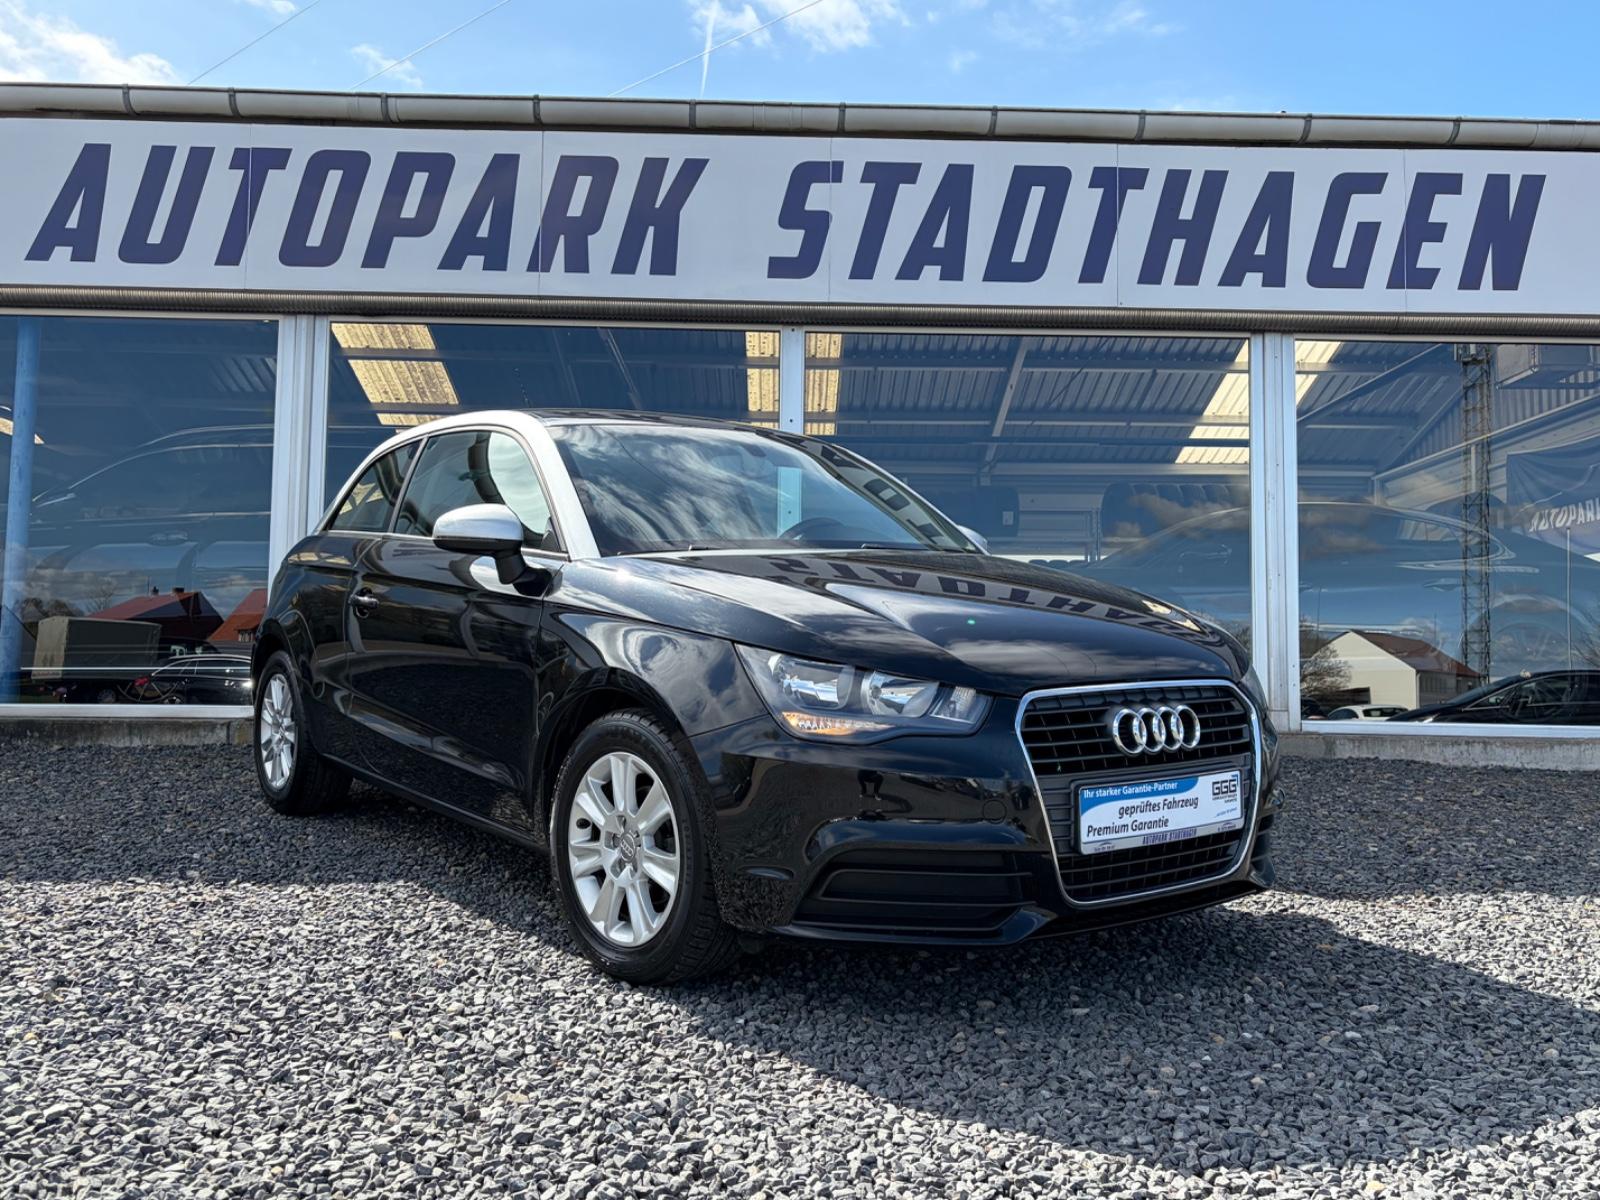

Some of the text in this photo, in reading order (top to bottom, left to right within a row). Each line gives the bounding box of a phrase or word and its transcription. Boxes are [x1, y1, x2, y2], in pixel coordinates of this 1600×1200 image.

[24, 142, 1547, 291] AUTOPARK STADTHAGEN
[1084, 782, 1178, 798] Ihr starker Garantie-Partner
[1212, 779, 1237, 796] GGG
[1118, 797, 1199, 819] geprüftes Fahrzeug
[1087, 816, 1169, 837] Premium Garantie
